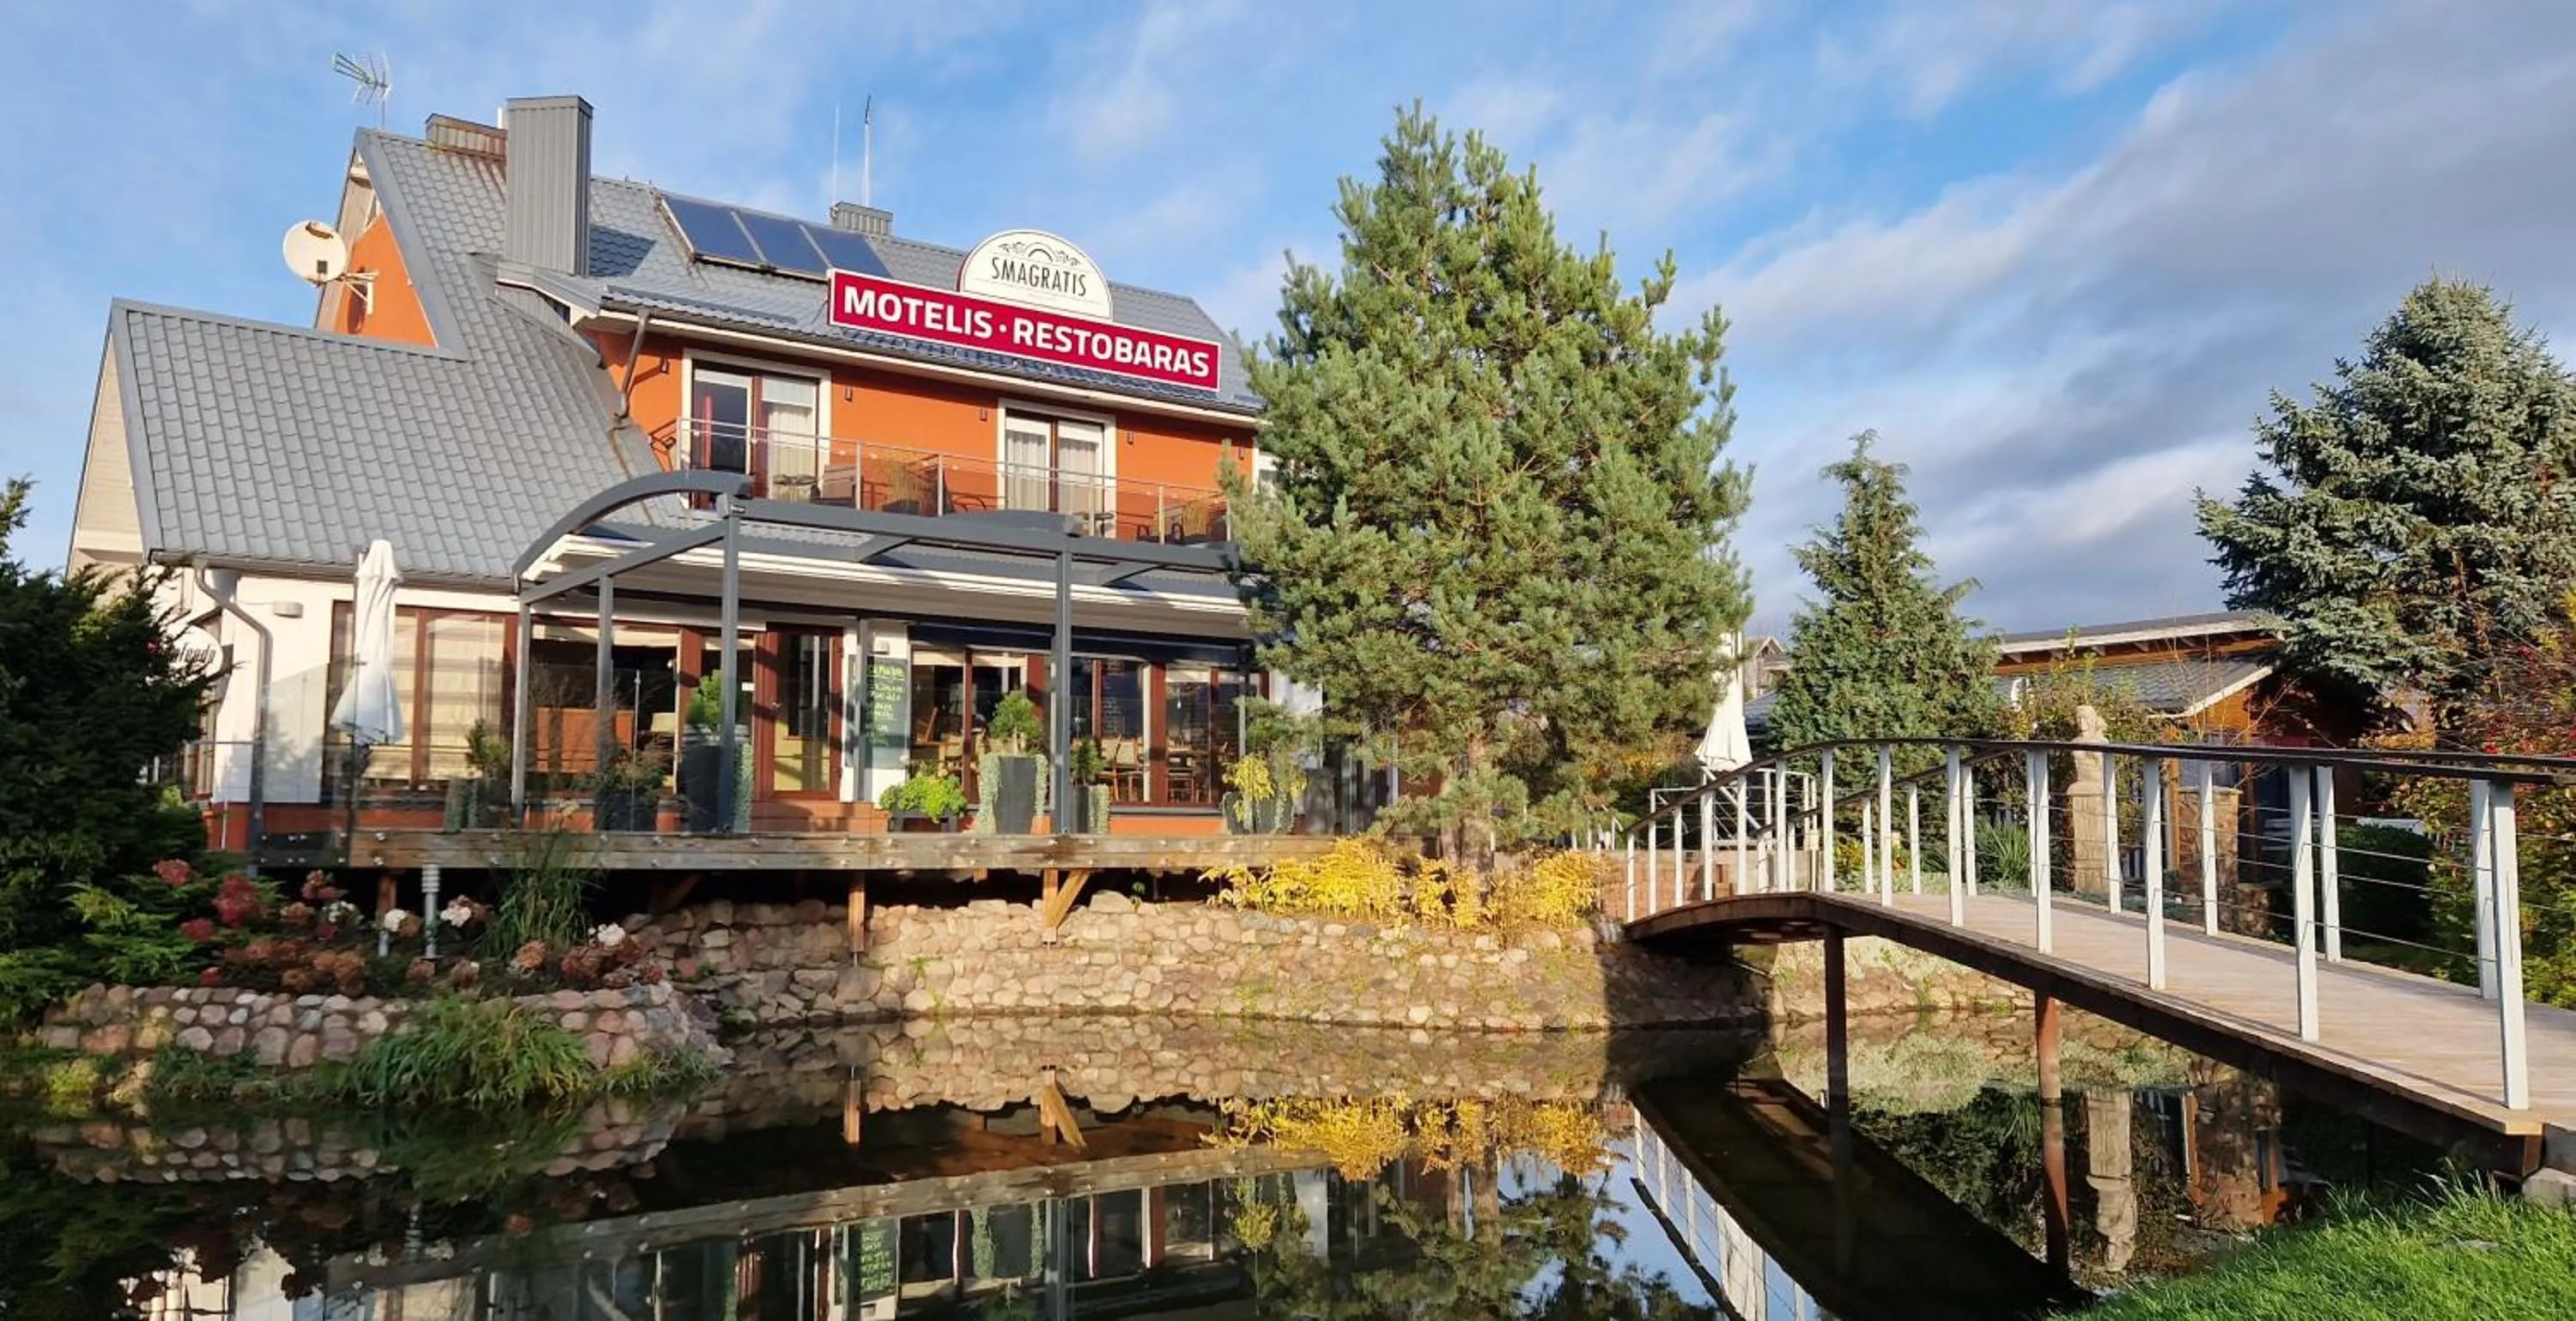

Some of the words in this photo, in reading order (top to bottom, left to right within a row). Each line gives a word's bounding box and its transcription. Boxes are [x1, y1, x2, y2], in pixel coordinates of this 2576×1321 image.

[992, 257, 1086, 296] SMAGRATIS
[843, 285, 993, 339] MOTELIS
[1013, 320, 1211, 378] RESTOBARAS
